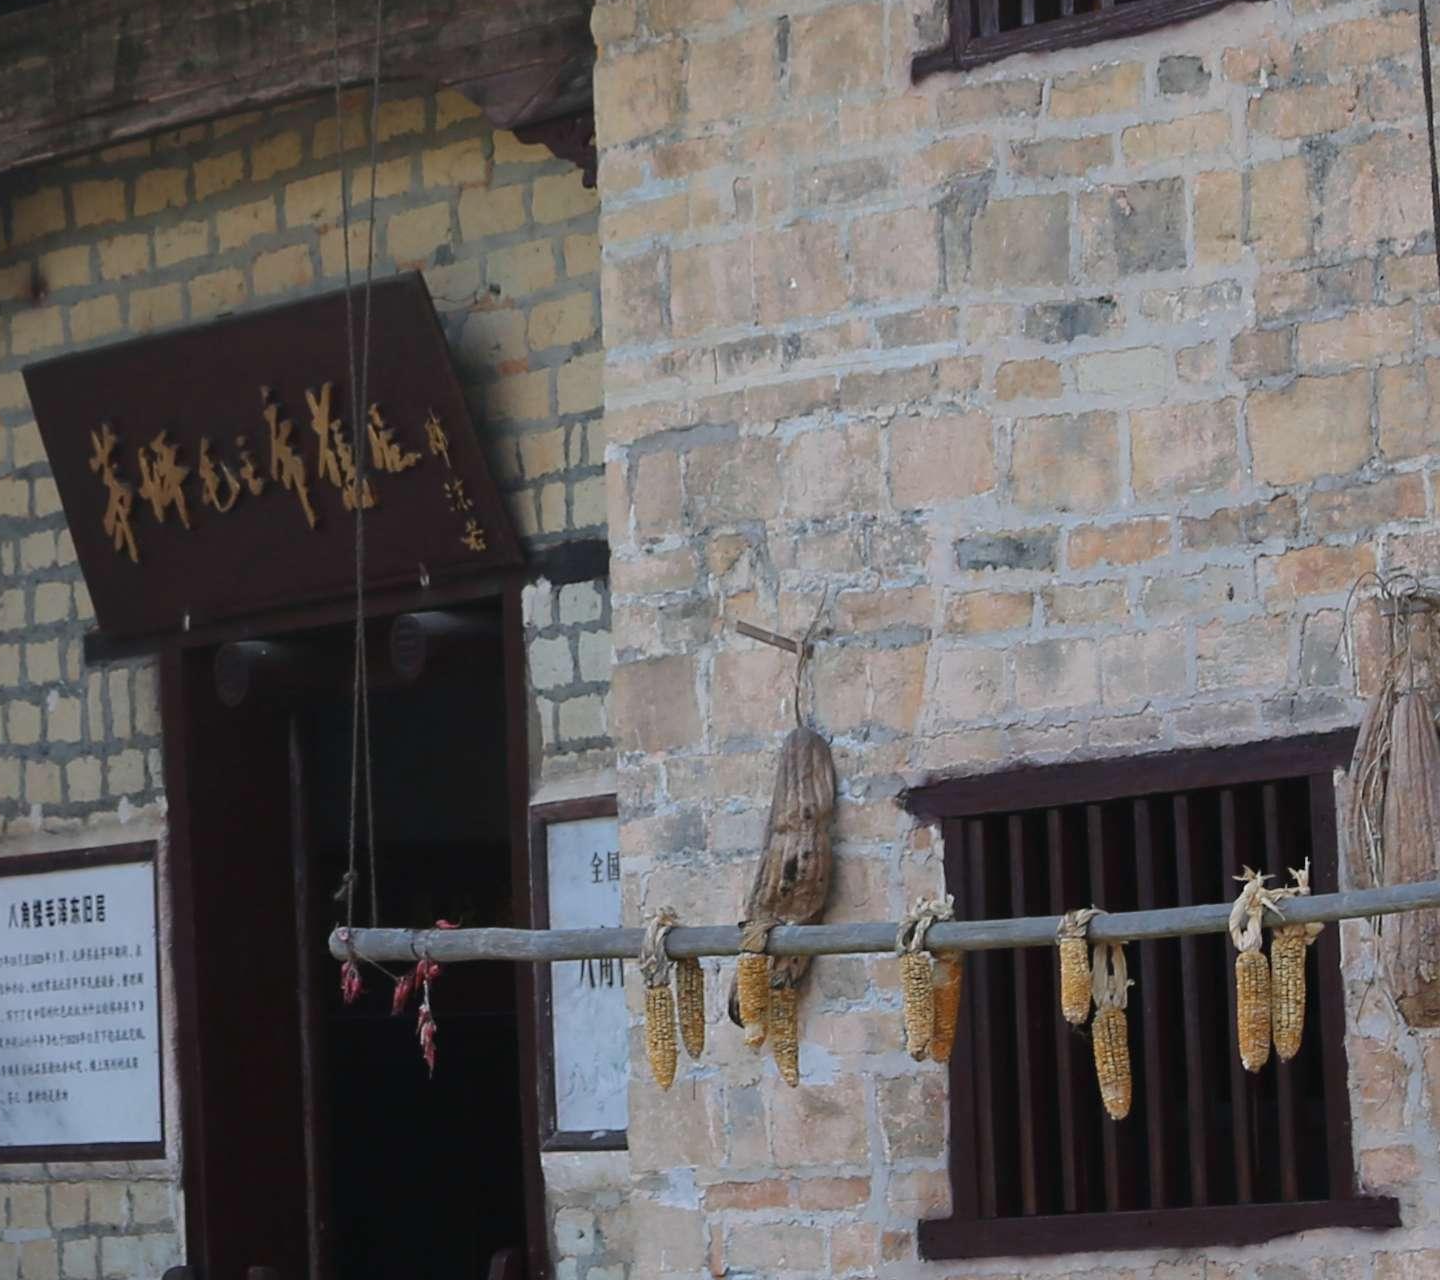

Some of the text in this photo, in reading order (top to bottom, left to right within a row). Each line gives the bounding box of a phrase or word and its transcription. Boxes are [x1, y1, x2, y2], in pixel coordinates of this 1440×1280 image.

[8, 894, 106, 929] 八角楼毛泽东旧居
